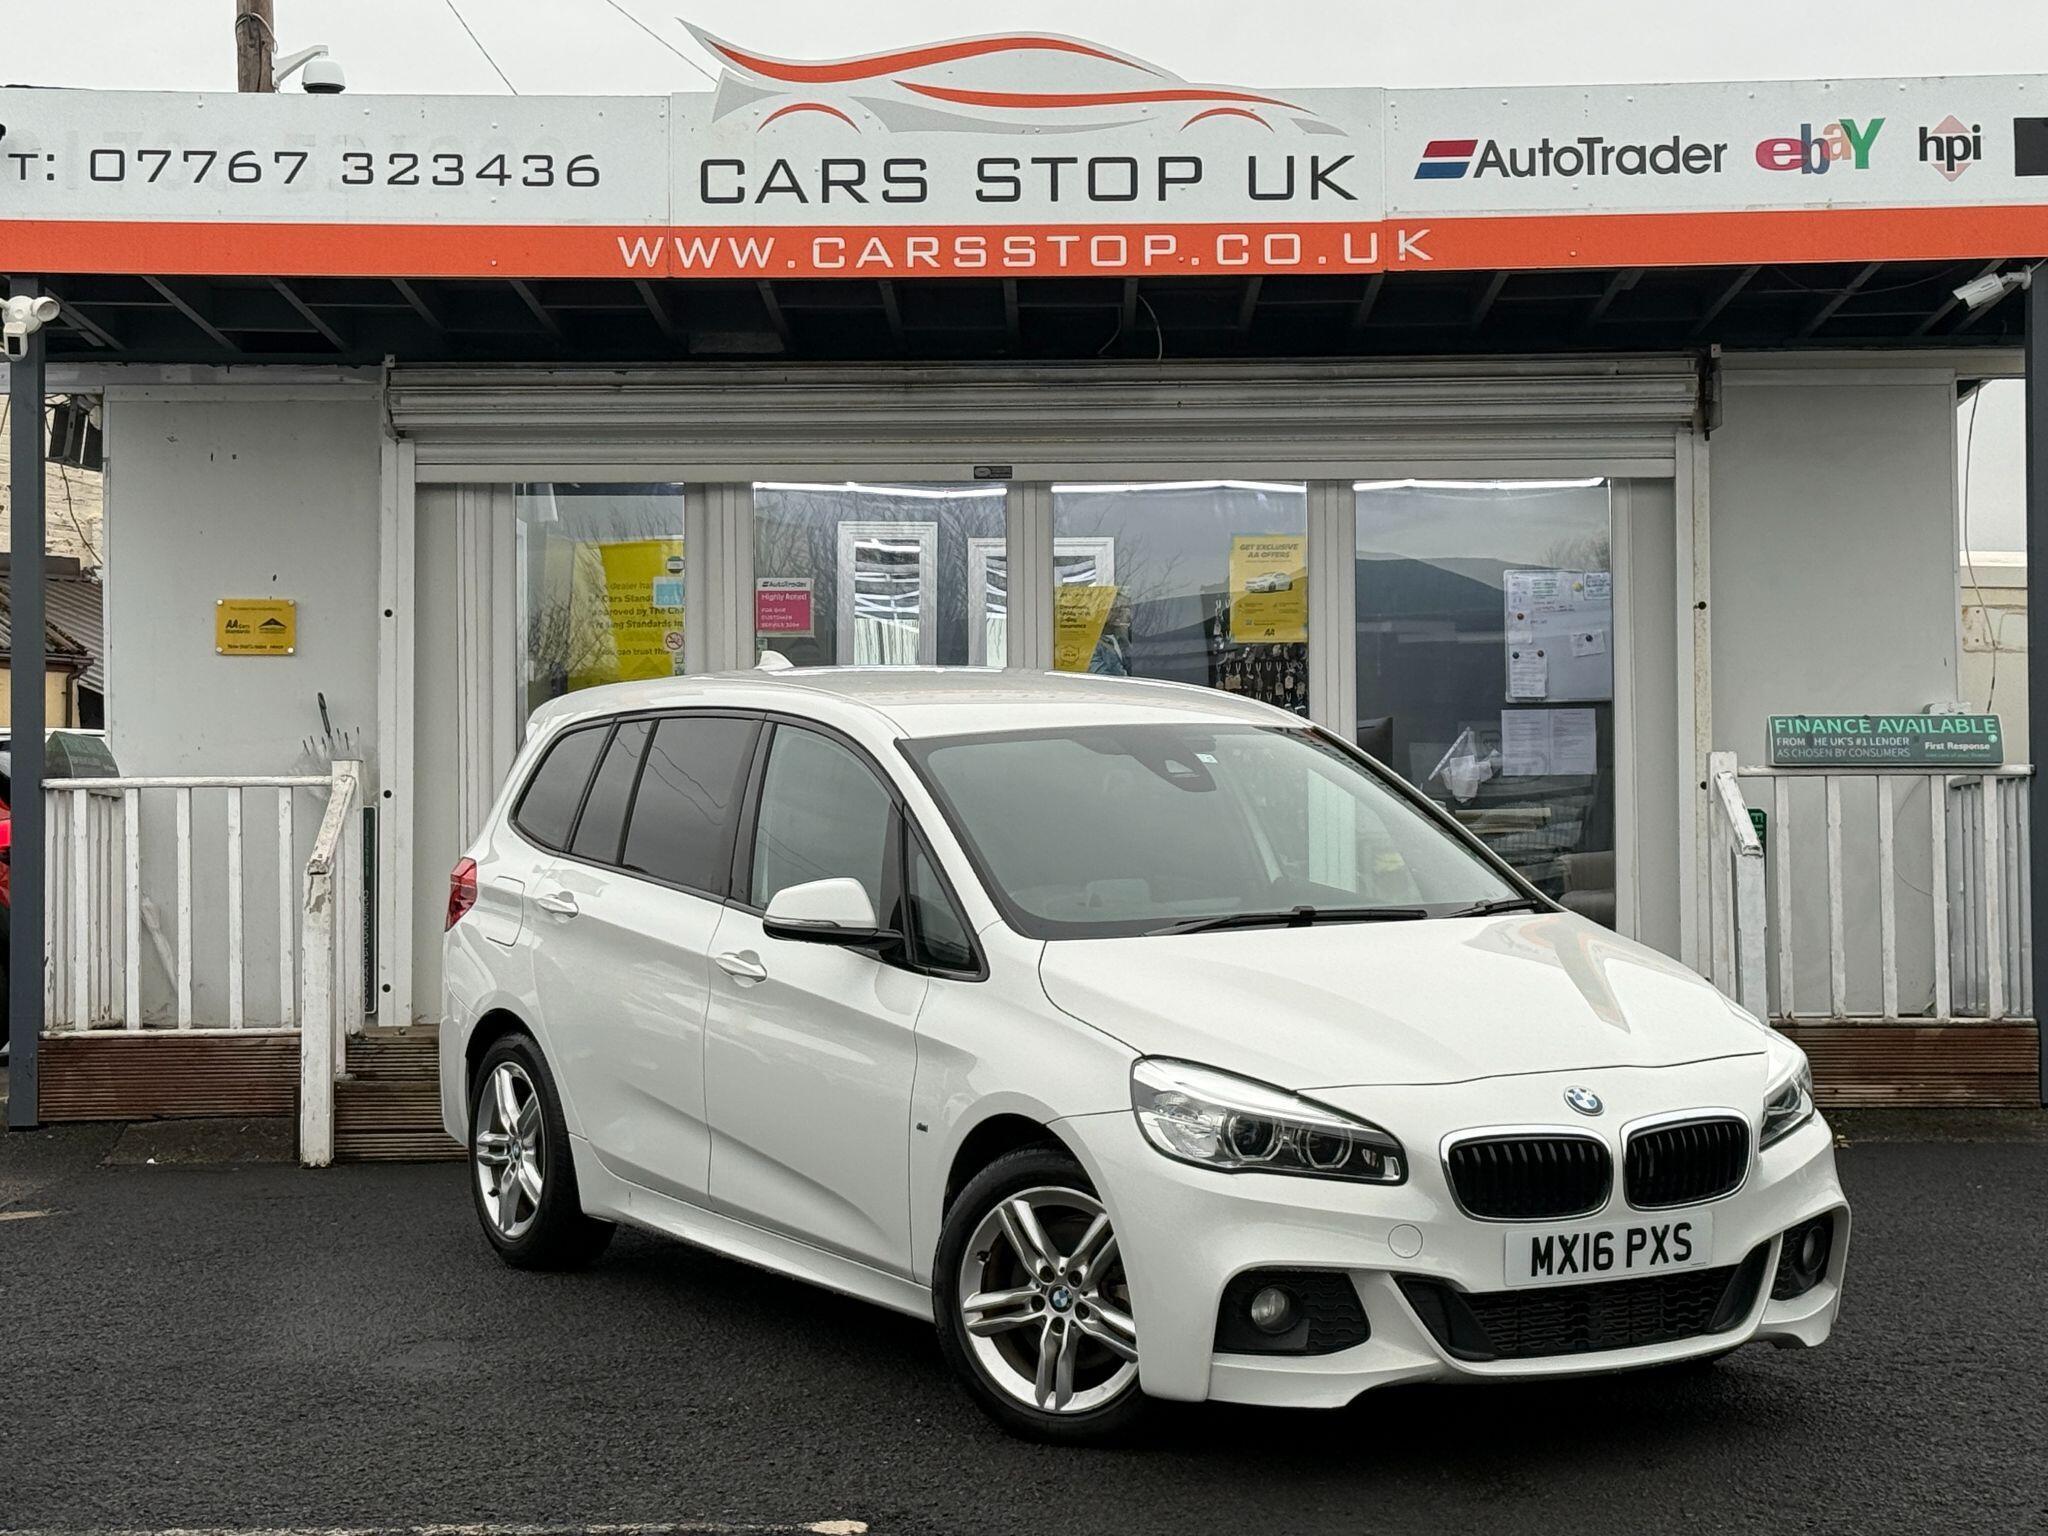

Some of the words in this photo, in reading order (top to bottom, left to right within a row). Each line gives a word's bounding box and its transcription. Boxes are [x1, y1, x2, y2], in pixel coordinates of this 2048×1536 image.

[1473, 136, 1728, 179] AutoTrader
[1919, 123, 1983, 172] hpi
[88, 148, 310, 185] 07767
[341, 152, 602, 188] 323436
[699, 158, 928, 204] CARS
[976, 155, 1204, 202] STOP
[1247, 154, 1360, 201] UK
[616, 228, 1434, 270] WWW.CARSSTOP.CO.UK
[626, 619, 671, 628] Standards
[1264, 628, 1275, 636] AA
[1774, 718, 1872, 734] FINANCE
[1877, 718, 1998, 734] AVAILABLE
[1776, 737, 1806, 746] FROM
[1830, 737, 1854, 746] UK'S
[1869, 737, 1911, 746] LENDER
[1776, 748, 1790, 758] AS
[1792, 748, 1834, 758] CHOSEN
[1834, 748, 1847, 758] BY
[1849, 748, 1911, 758] CONSUMERS
[1924, 742, 1944, 750] First
[1947, 742, 1991, 752] Response
[1531, 1231, 1614, 1277] MX16
[1626, 1222, 1692, 1268] PXS
